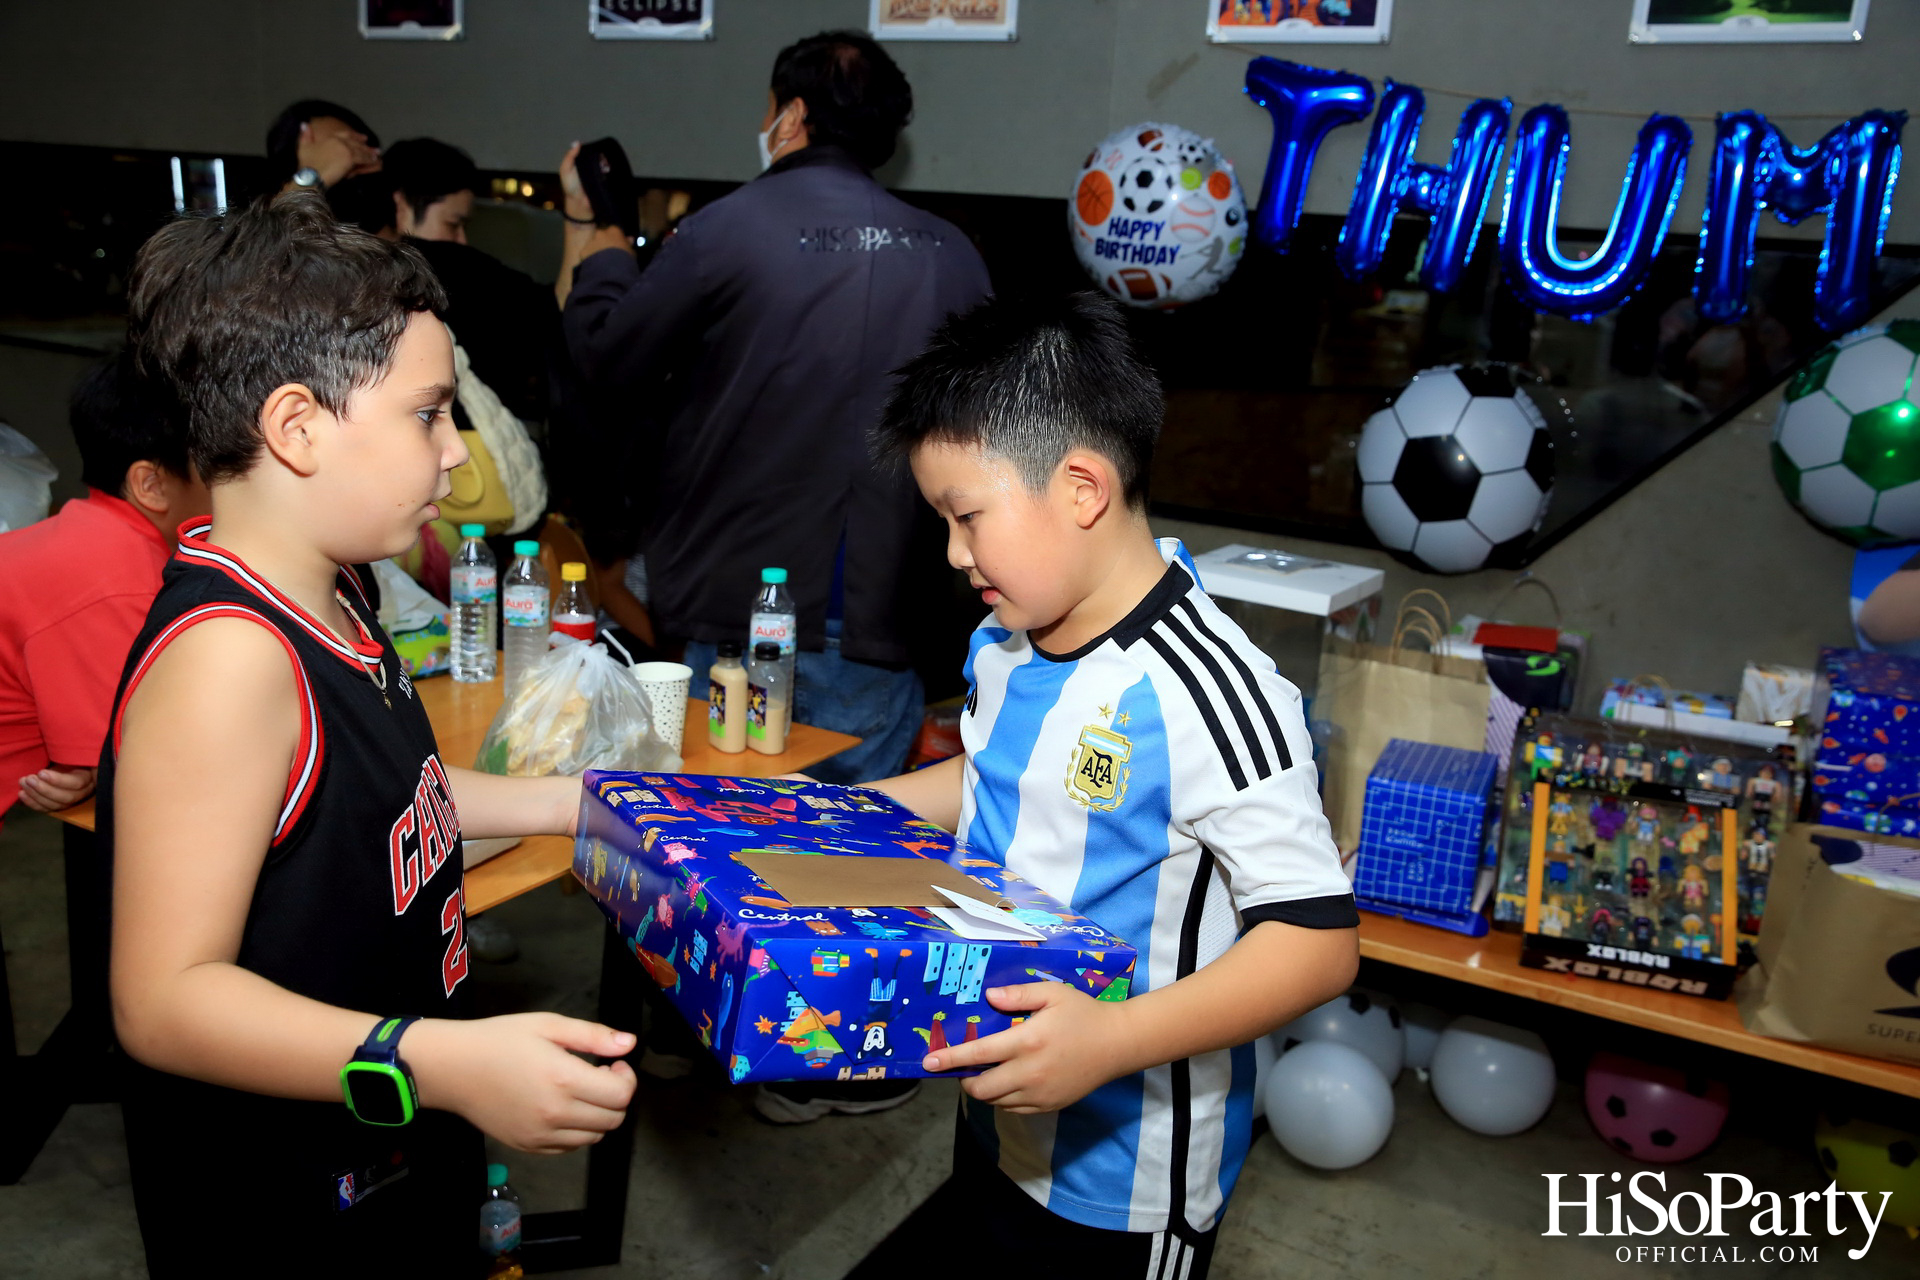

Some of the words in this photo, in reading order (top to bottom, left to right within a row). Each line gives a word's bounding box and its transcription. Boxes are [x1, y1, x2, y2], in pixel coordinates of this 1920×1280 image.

[1242, 55, 1908, 332] THUM
[1108, 217, 1166, 241] HAPPY
[1094, 238, 1182, 266] BIRTHDAY
[1081, 748, 1112, 788] AFA
[738, 908, 829, 922] Central
[1586, 943, 1670, 969] ROBLOX
[1543, 956, 1709, 995] ROBLOX
[1866, 1023, 1920, 1043] SUPE
